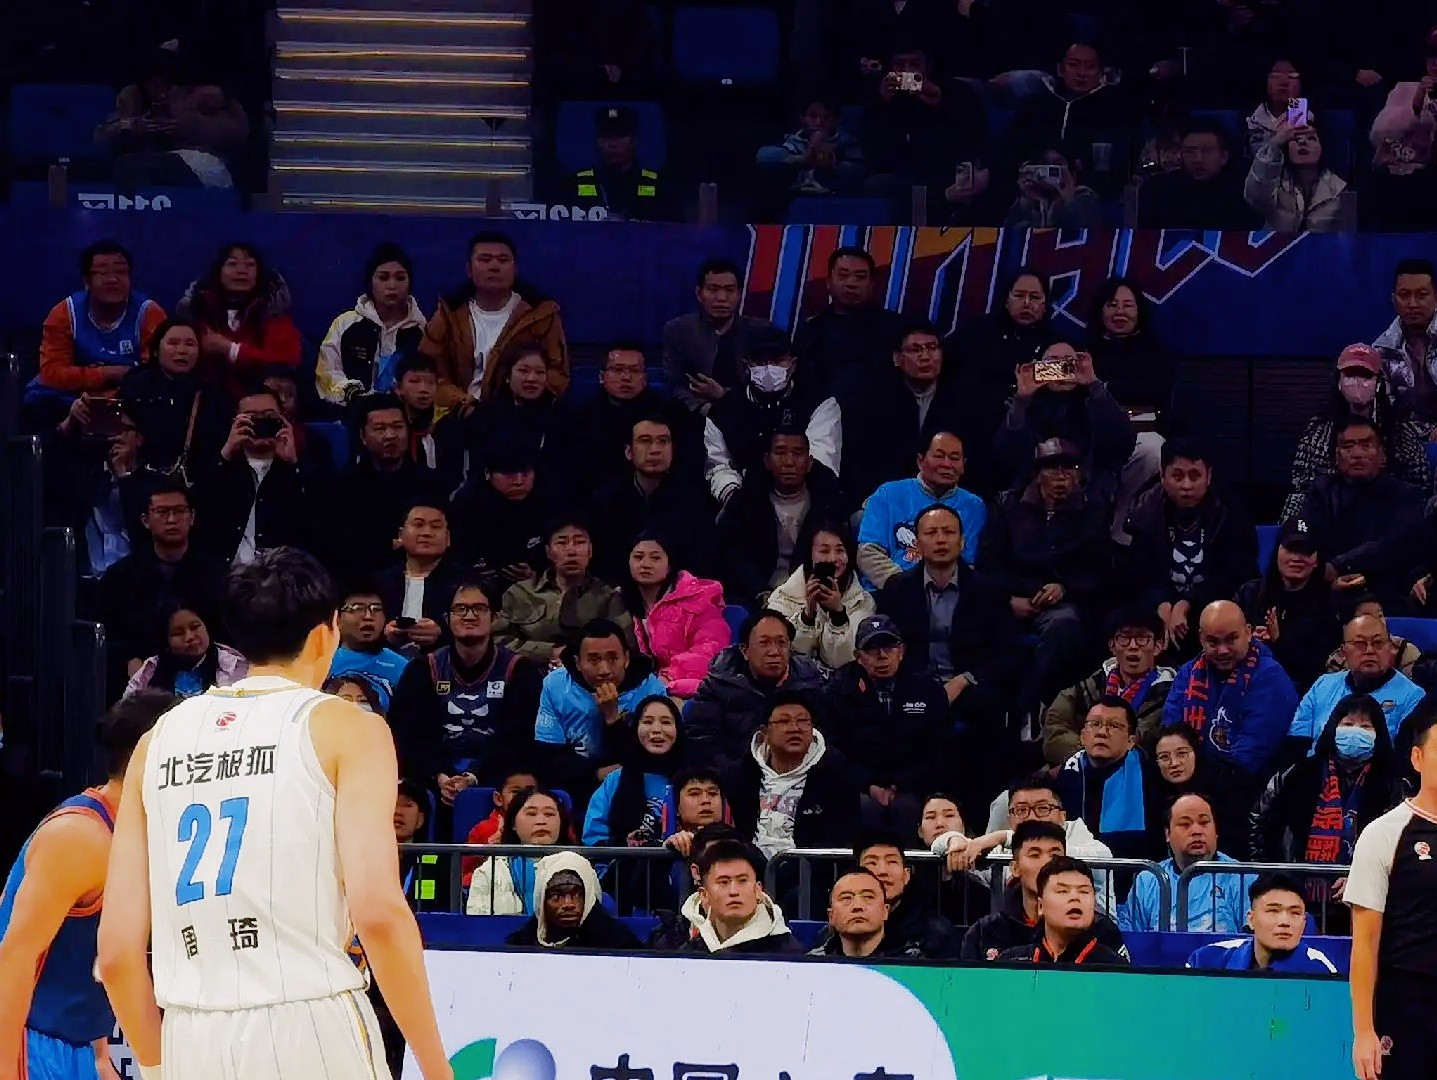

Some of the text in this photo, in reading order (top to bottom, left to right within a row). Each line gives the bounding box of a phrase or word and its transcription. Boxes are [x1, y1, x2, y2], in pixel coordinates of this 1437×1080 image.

[158, 745, 277, 790] 北汽极狐
[176, 797, 250, 907] 27
